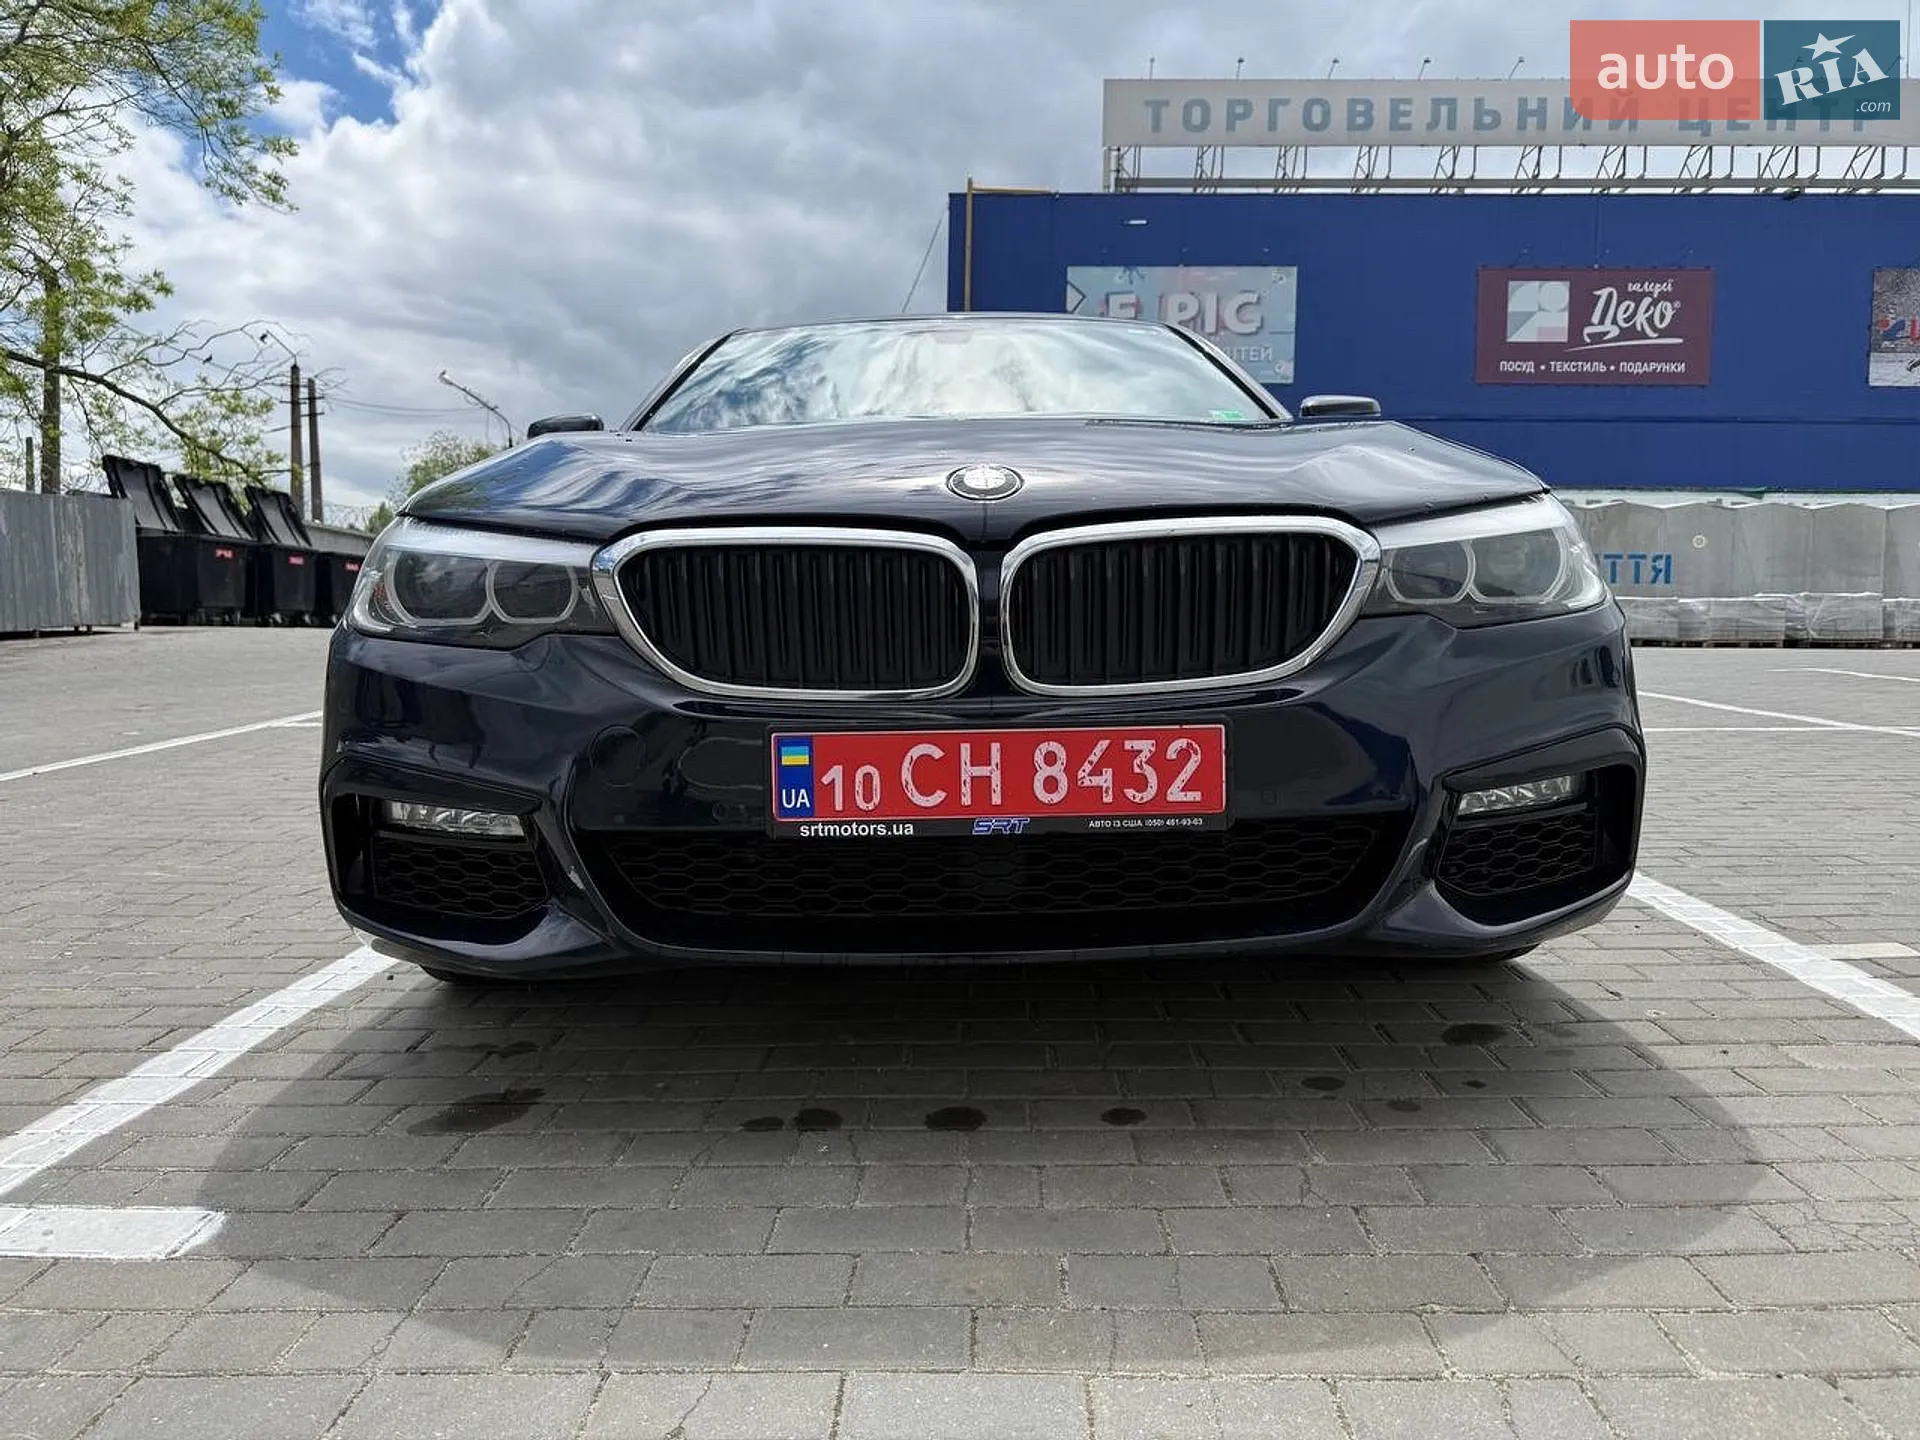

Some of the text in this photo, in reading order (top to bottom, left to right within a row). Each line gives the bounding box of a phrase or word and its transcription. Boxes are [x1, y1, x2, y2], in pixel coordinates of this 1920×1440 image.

[1144, 89, 1881, 137] ТОРГОВЕЛЬНИЙ ЦЕНТР
[1500, 361, 1686, 373] ПОСУД ТЕКСТИЛЬ ПОДАРУНКИ
[1596, 553, 1671, 584] ТТЯ
[820, 764, 881, 811] 10
[1033, 738, 1202, 804] 8432
[782, 789, 810, 808] UA
[800, 821, 914, 837] srtmotors.ua
[972, 817, 1030, 835] SRT
